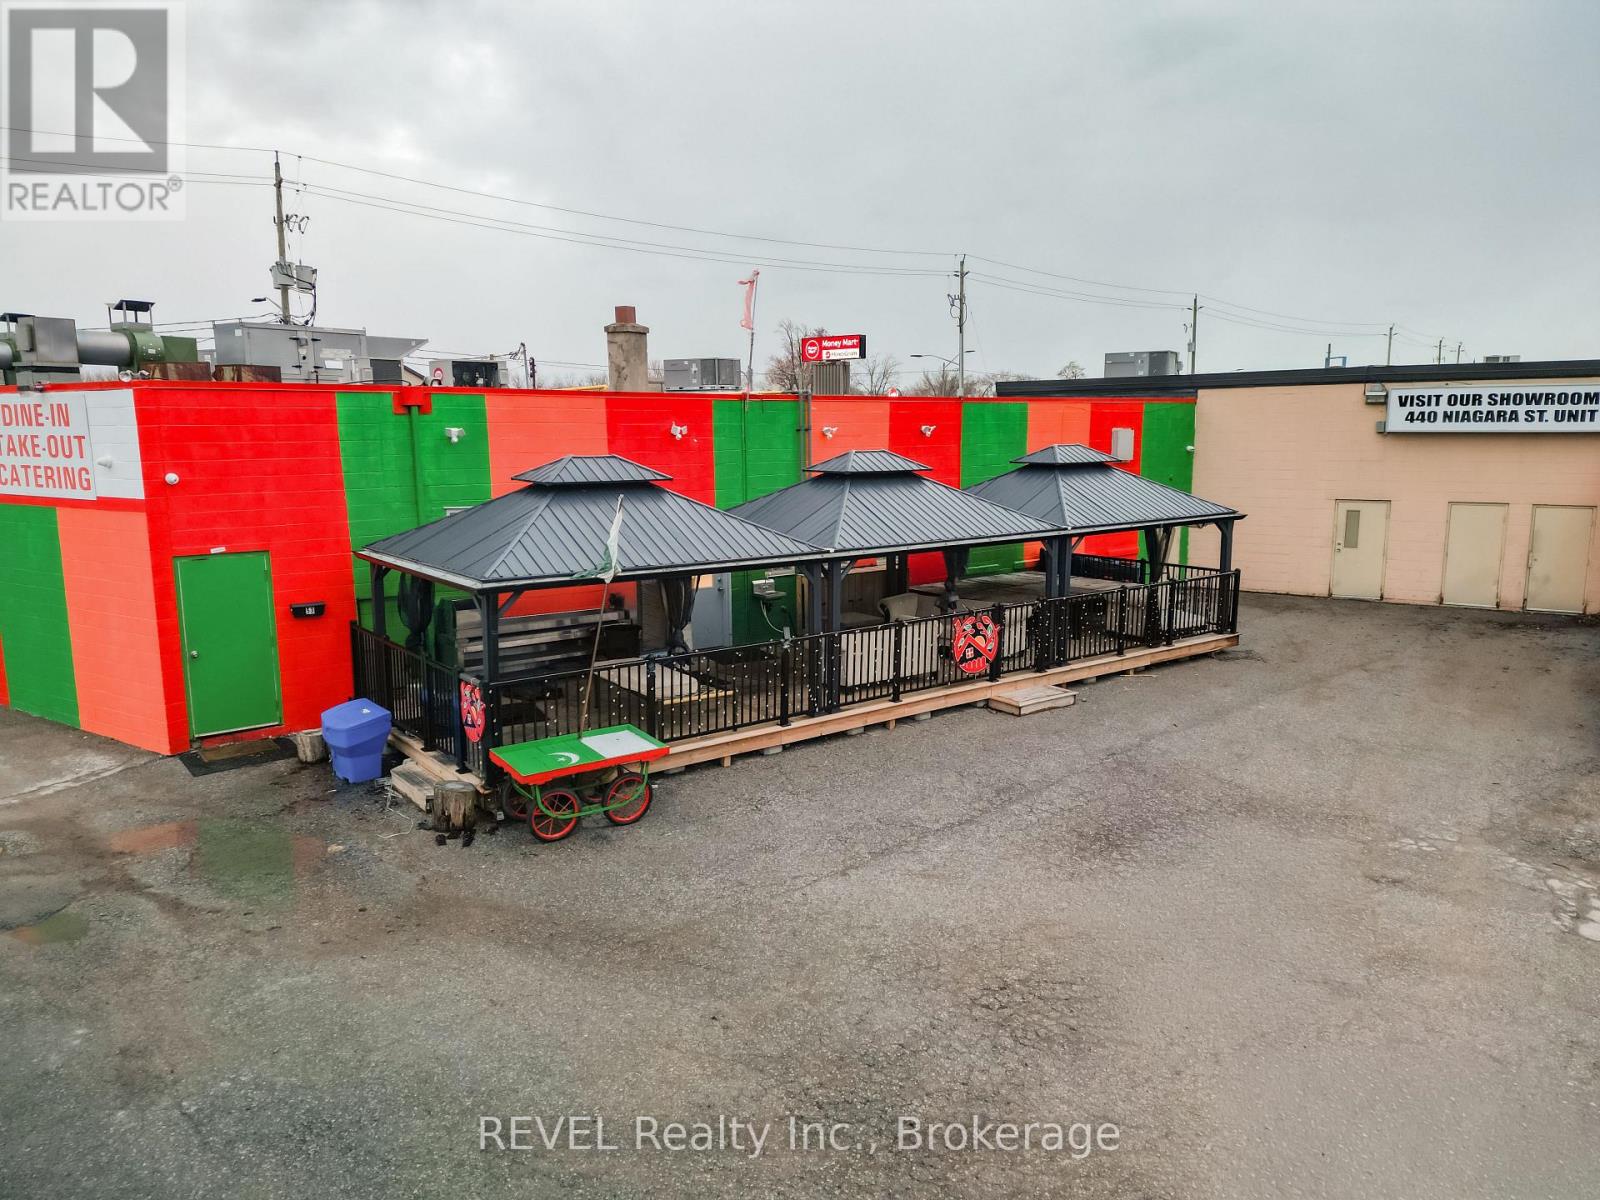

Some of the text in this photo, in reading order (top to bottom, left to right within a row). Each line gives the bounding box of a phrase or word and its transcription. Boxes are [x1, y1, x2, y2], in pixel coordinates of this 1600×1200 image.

[822, 340, 841, 348] Money
[1398, 392, 1600, 407] VISIT OUR SHOWROOM
[2, 403, 70, 427] DINE-IN
[1405, 409, 1598, 423] 440 NIAGARA ST. UNIT
[0, 464, 92, 491] CATERING
